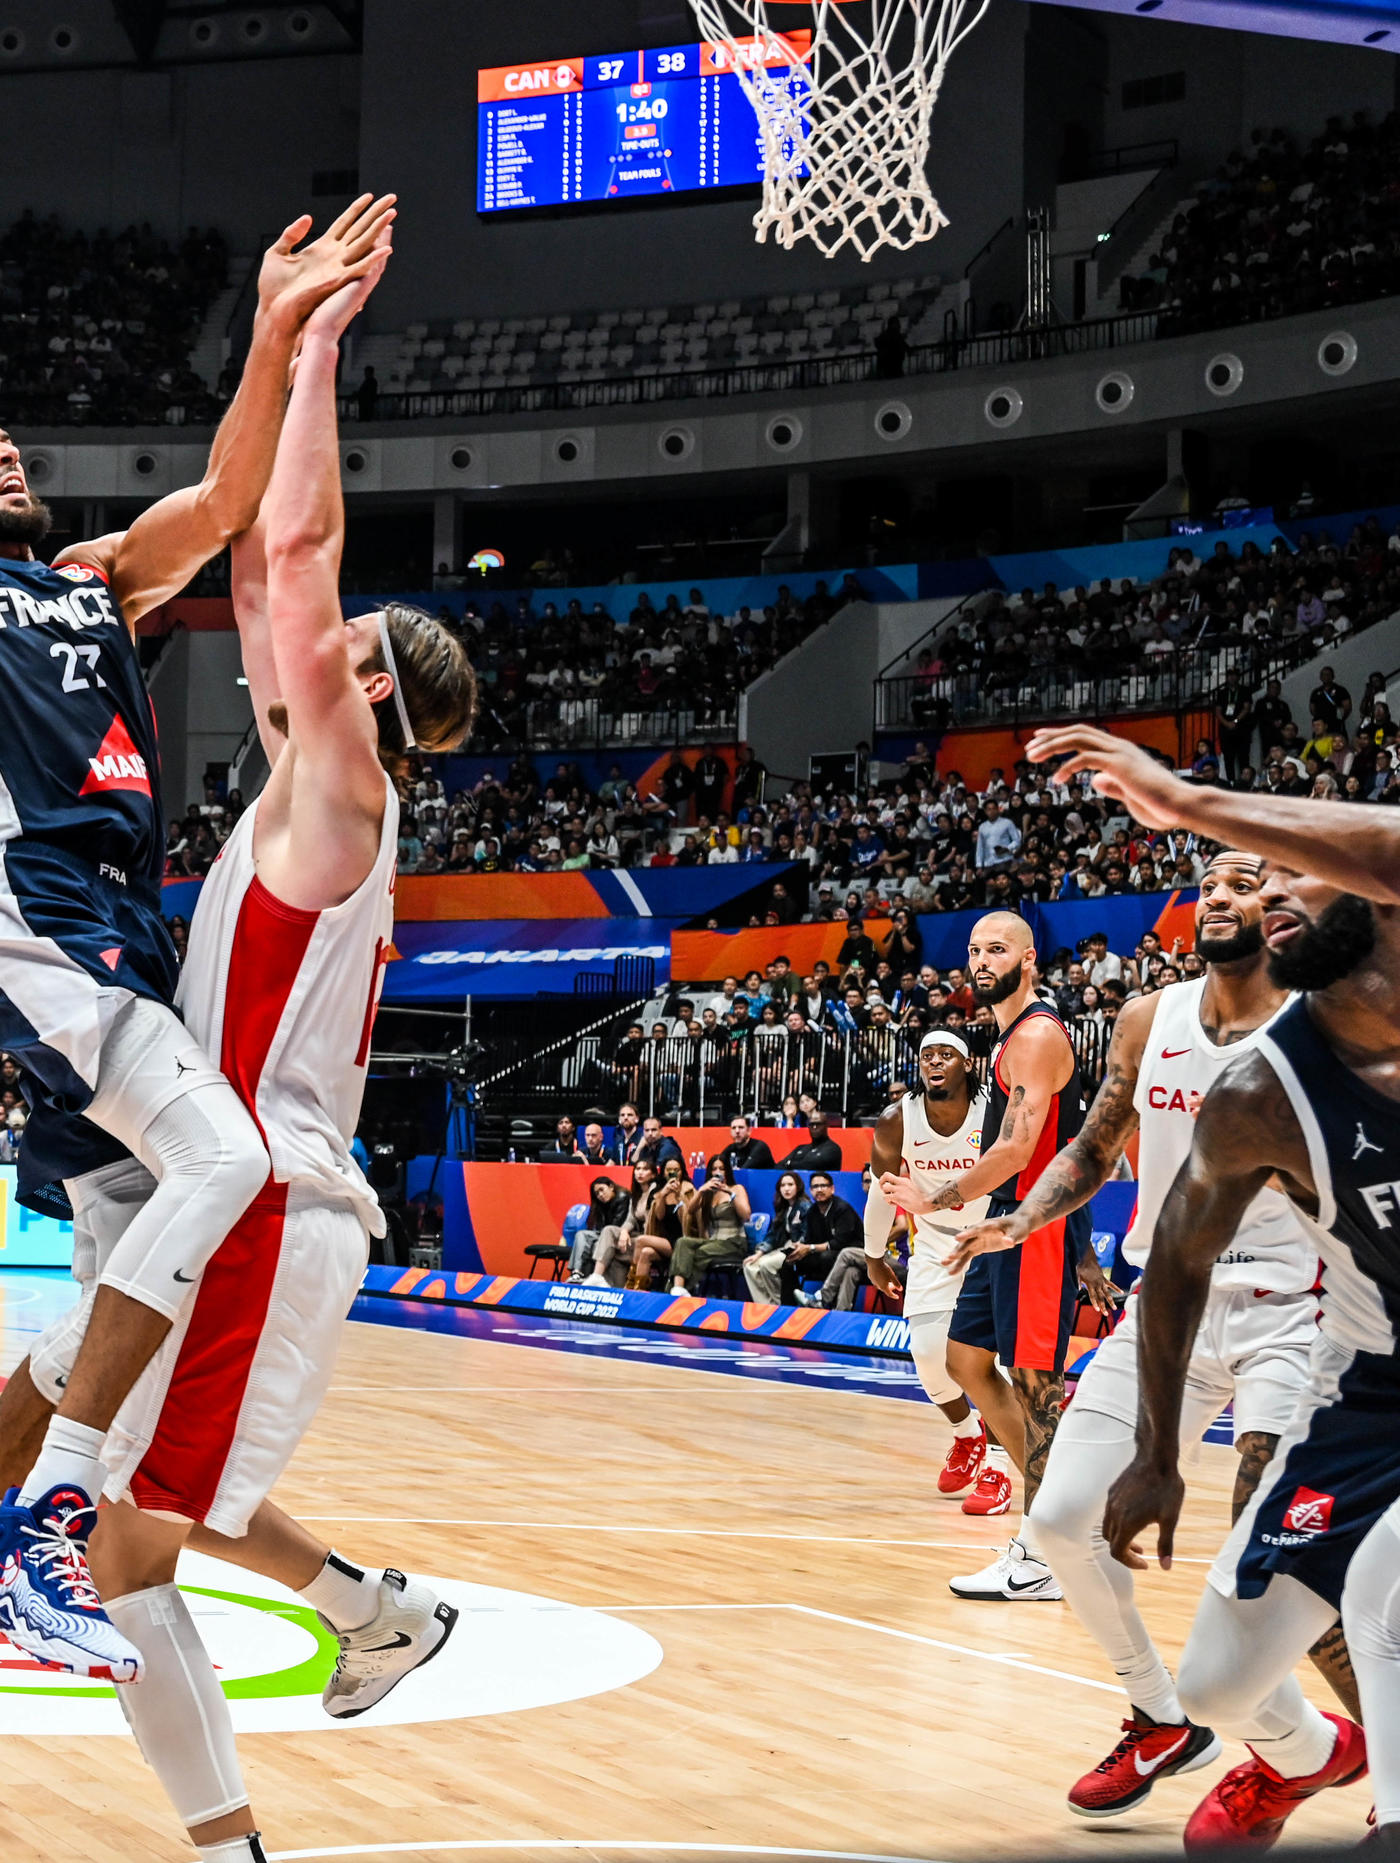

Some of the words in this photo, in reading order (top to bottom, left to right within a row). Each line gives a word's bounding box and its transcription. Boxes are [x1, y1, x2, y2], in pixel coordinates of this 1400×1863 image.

[504, 68, 550, 92] CAN
[597, 60, 625, 81] 37
[657, 52, 686, 74] 38
[616, 98, 668, 123] 1:40
[621, 138, 660, 151] TIME-OUTS
[619, 170, 638, 181] TEAM
[99, 862, 127, 886] FRA
[414, 945, 670, 965] JAKARTA
[549, 1286, 570, 1298] FIBA
[570, 1287, 625, 1305] BASKETBALL
[543, 1298, 577, 1314] WORLD
[575, 1301, 596, 1316] CUP
[594, 1304, 619, 1318] 2023
